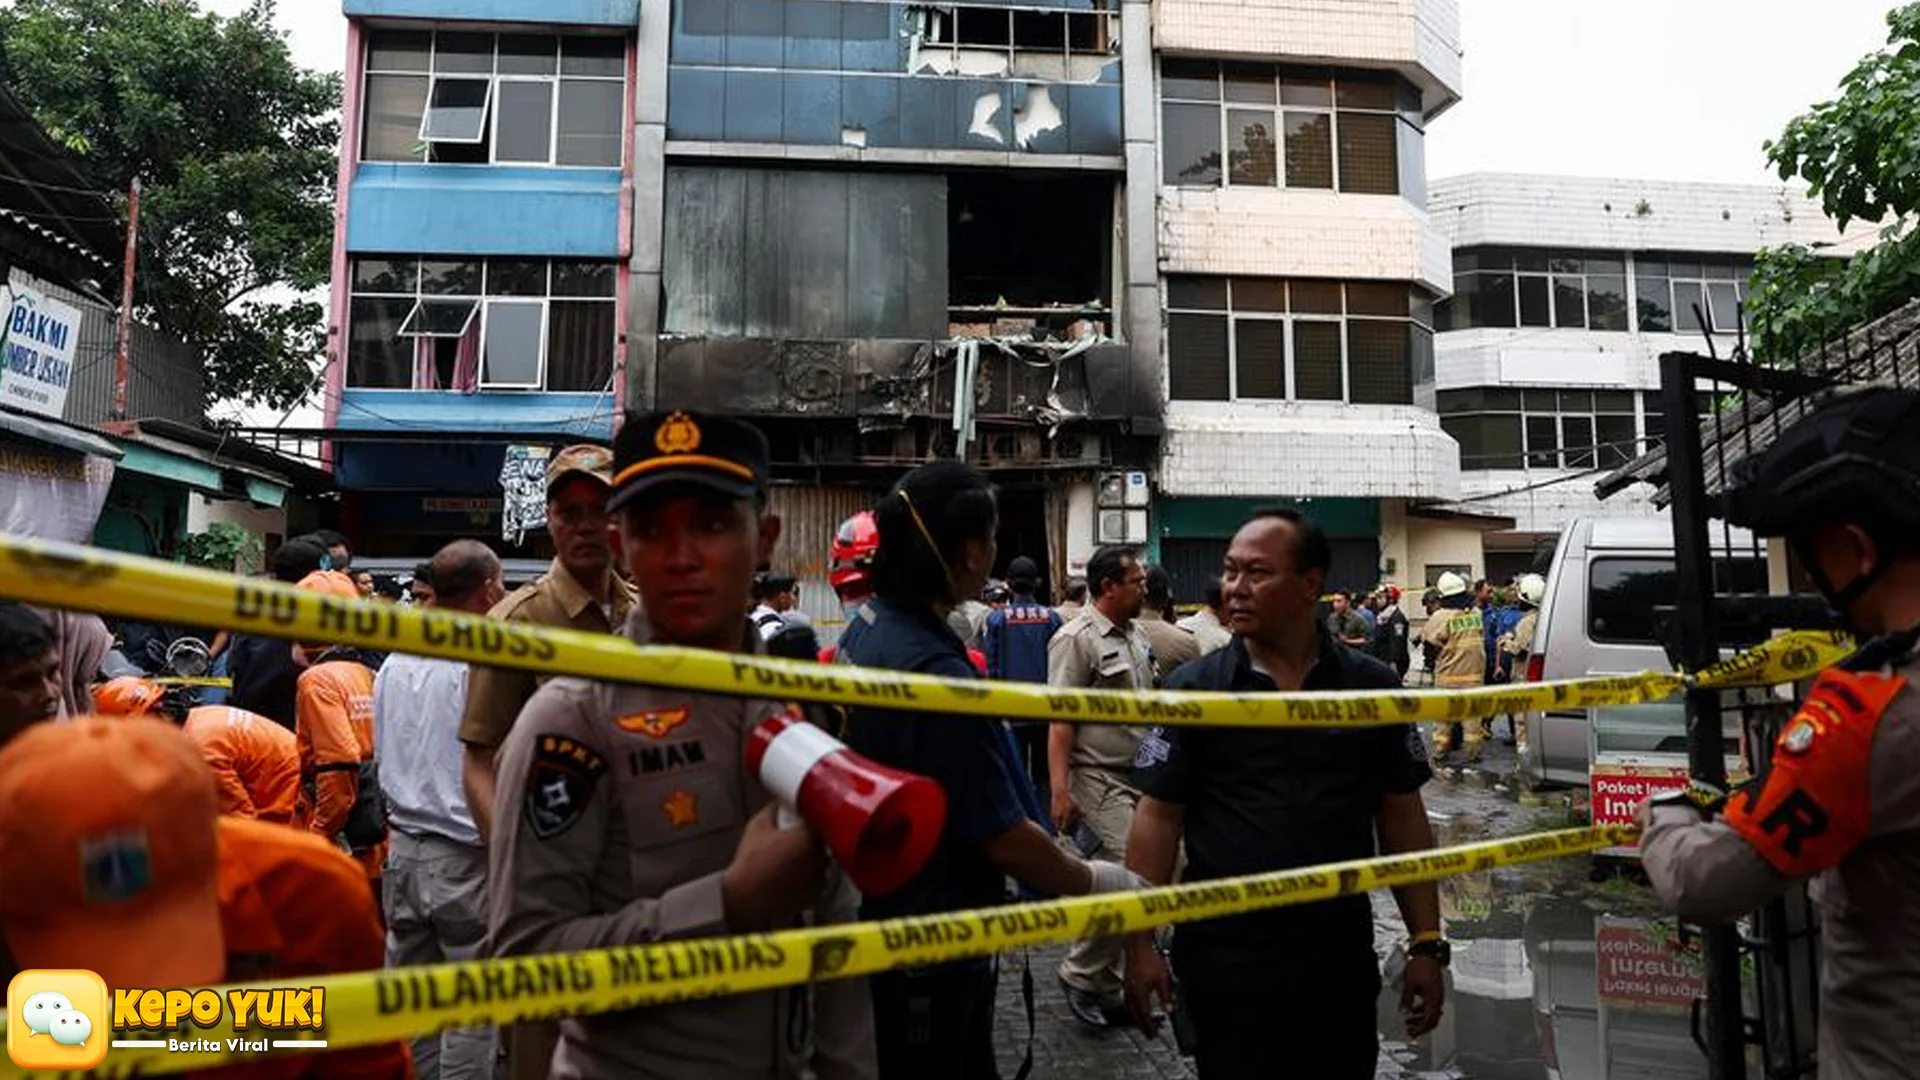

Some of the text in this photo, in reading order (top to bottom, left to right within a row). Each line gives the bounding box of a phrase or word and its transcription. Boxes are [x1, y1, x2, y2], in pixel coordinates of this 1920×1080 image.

[12, 305, 69, 352] BAKMI
[235, 584, 557, 661] DO NOT CROSS
[730, 658, 918, 701] POLICE LINE
[1049, 694, 1081, 713] DO
[1085, 695, 1129, 716] NOT
[1284, 696, 1380, 721] POLICE LINE
[629, 739, 706, 777] IMAM
[1597, 780, 1643, 796] Paket
[1138, 872, 1330, 915] DILARANG MELINTAS
[881, 919, 974, 952] GARIS
[979, 906, 1069, 938] POLISI
[376, 953, 595, 1016] DILARANG
[609, 939, 787, 987] MELINTAS
